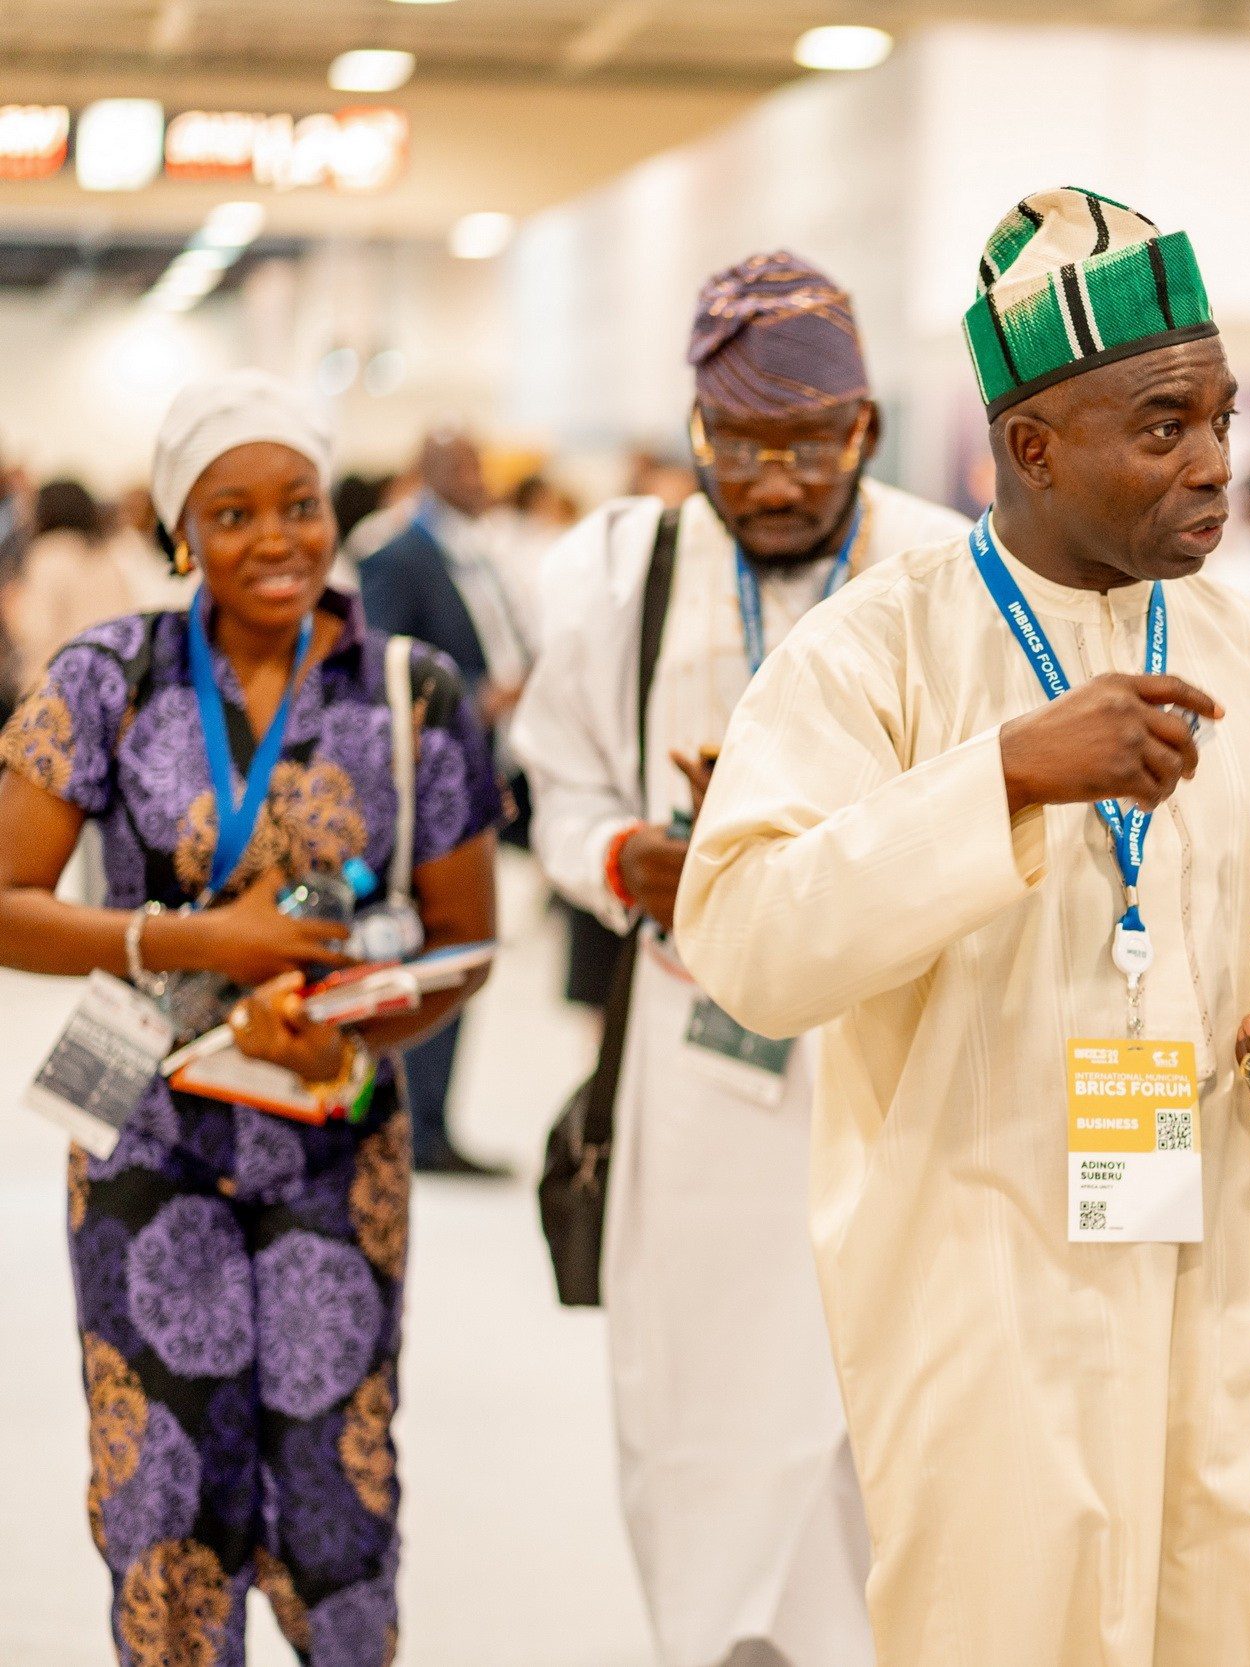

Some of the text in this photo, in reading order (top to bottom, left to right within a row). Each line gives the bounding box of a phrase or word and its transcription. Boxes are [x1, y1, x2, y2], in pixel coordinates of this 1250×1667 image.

[1008, 601, 1044, 653] IMBRICS
[1152, 605, 1165, 653] FORUM
[1129, 809, 1145, 866] IMBRICS
[1075, 1072, 1190, 1083] INTERNATIONAL MUNICIPAL
[1075, 1080, 1192, 1097] BRICS FORUM
[1076, 1118, 1139, 1129] BUSINESS
[1081, 1161, 1126, 1170] ADINOYI
[1081, 1171, 1122, 1181] SUBERU
